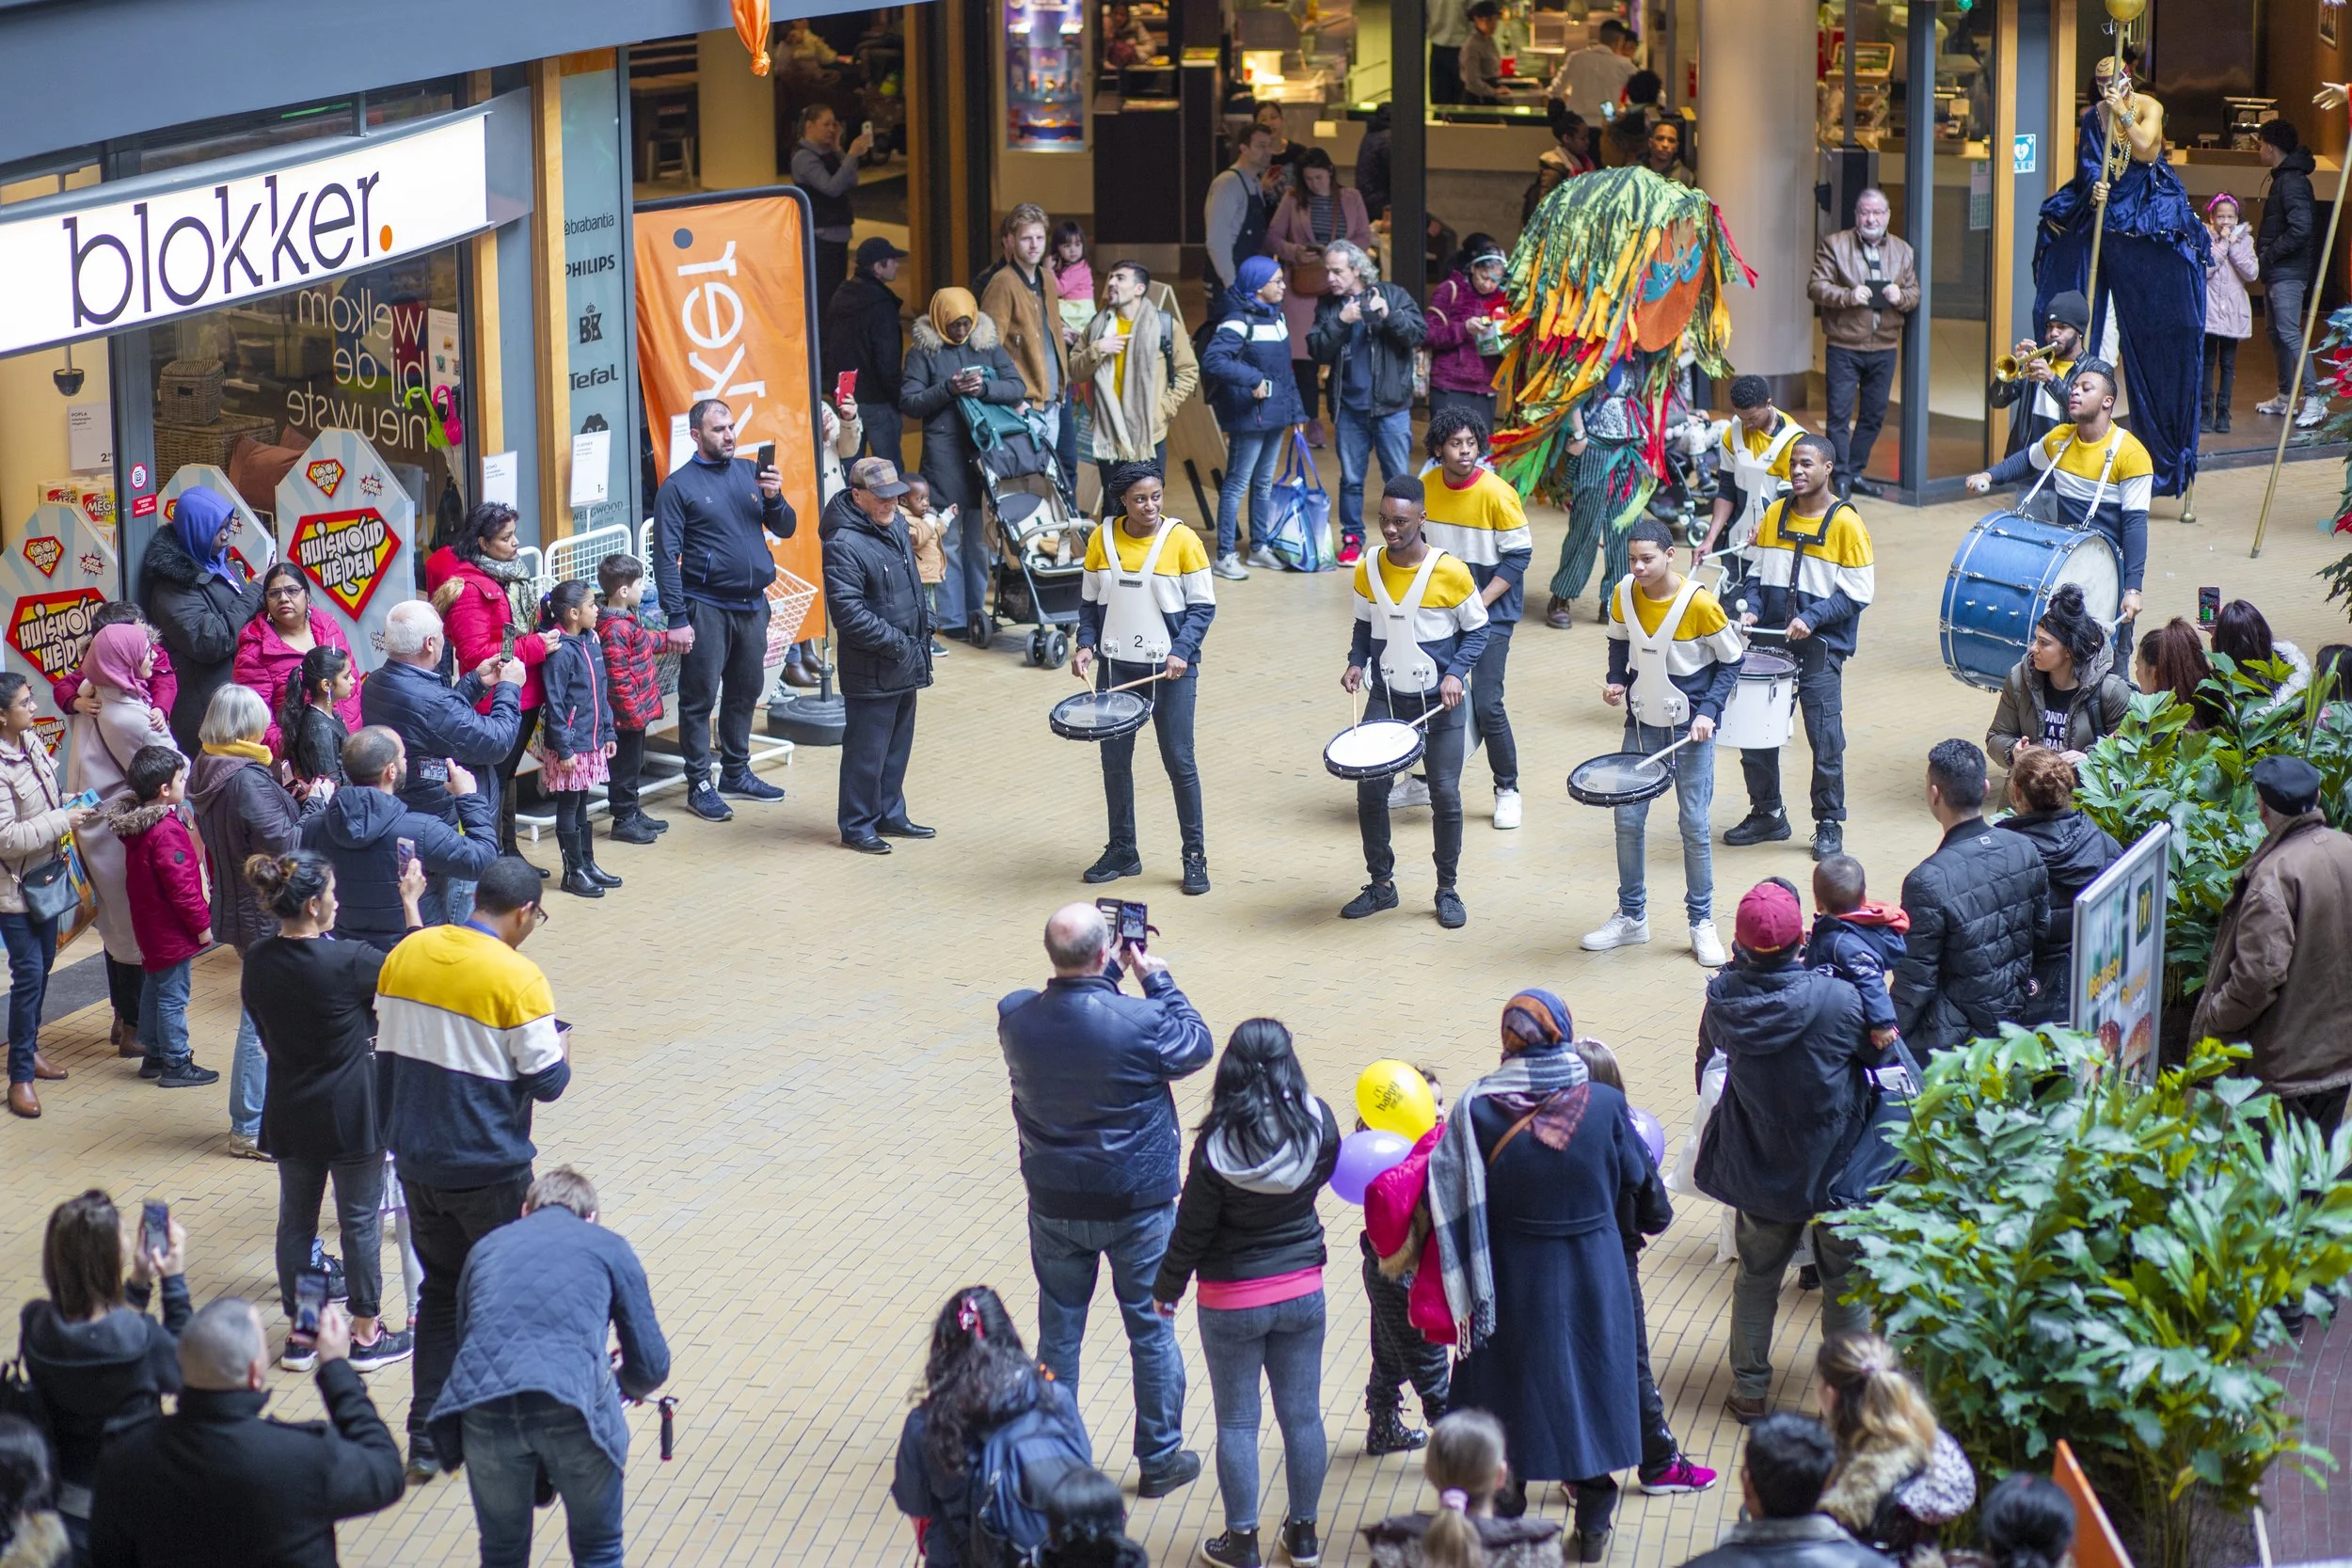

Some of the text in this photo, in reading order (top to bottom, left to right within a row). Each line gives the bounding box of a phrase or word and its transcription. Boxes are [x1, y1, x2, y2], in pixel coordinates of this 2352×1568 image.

[570, 212, 614, 234] brabantia
[565, 254, 615, 279] PHILIPS
[568, 363, 619, 391] Tefal
[300, 515, 385, 566] HUISHOUD
[321, 550, 376, 594] HELDEN
[1134, 634, 1143, 648] 2
